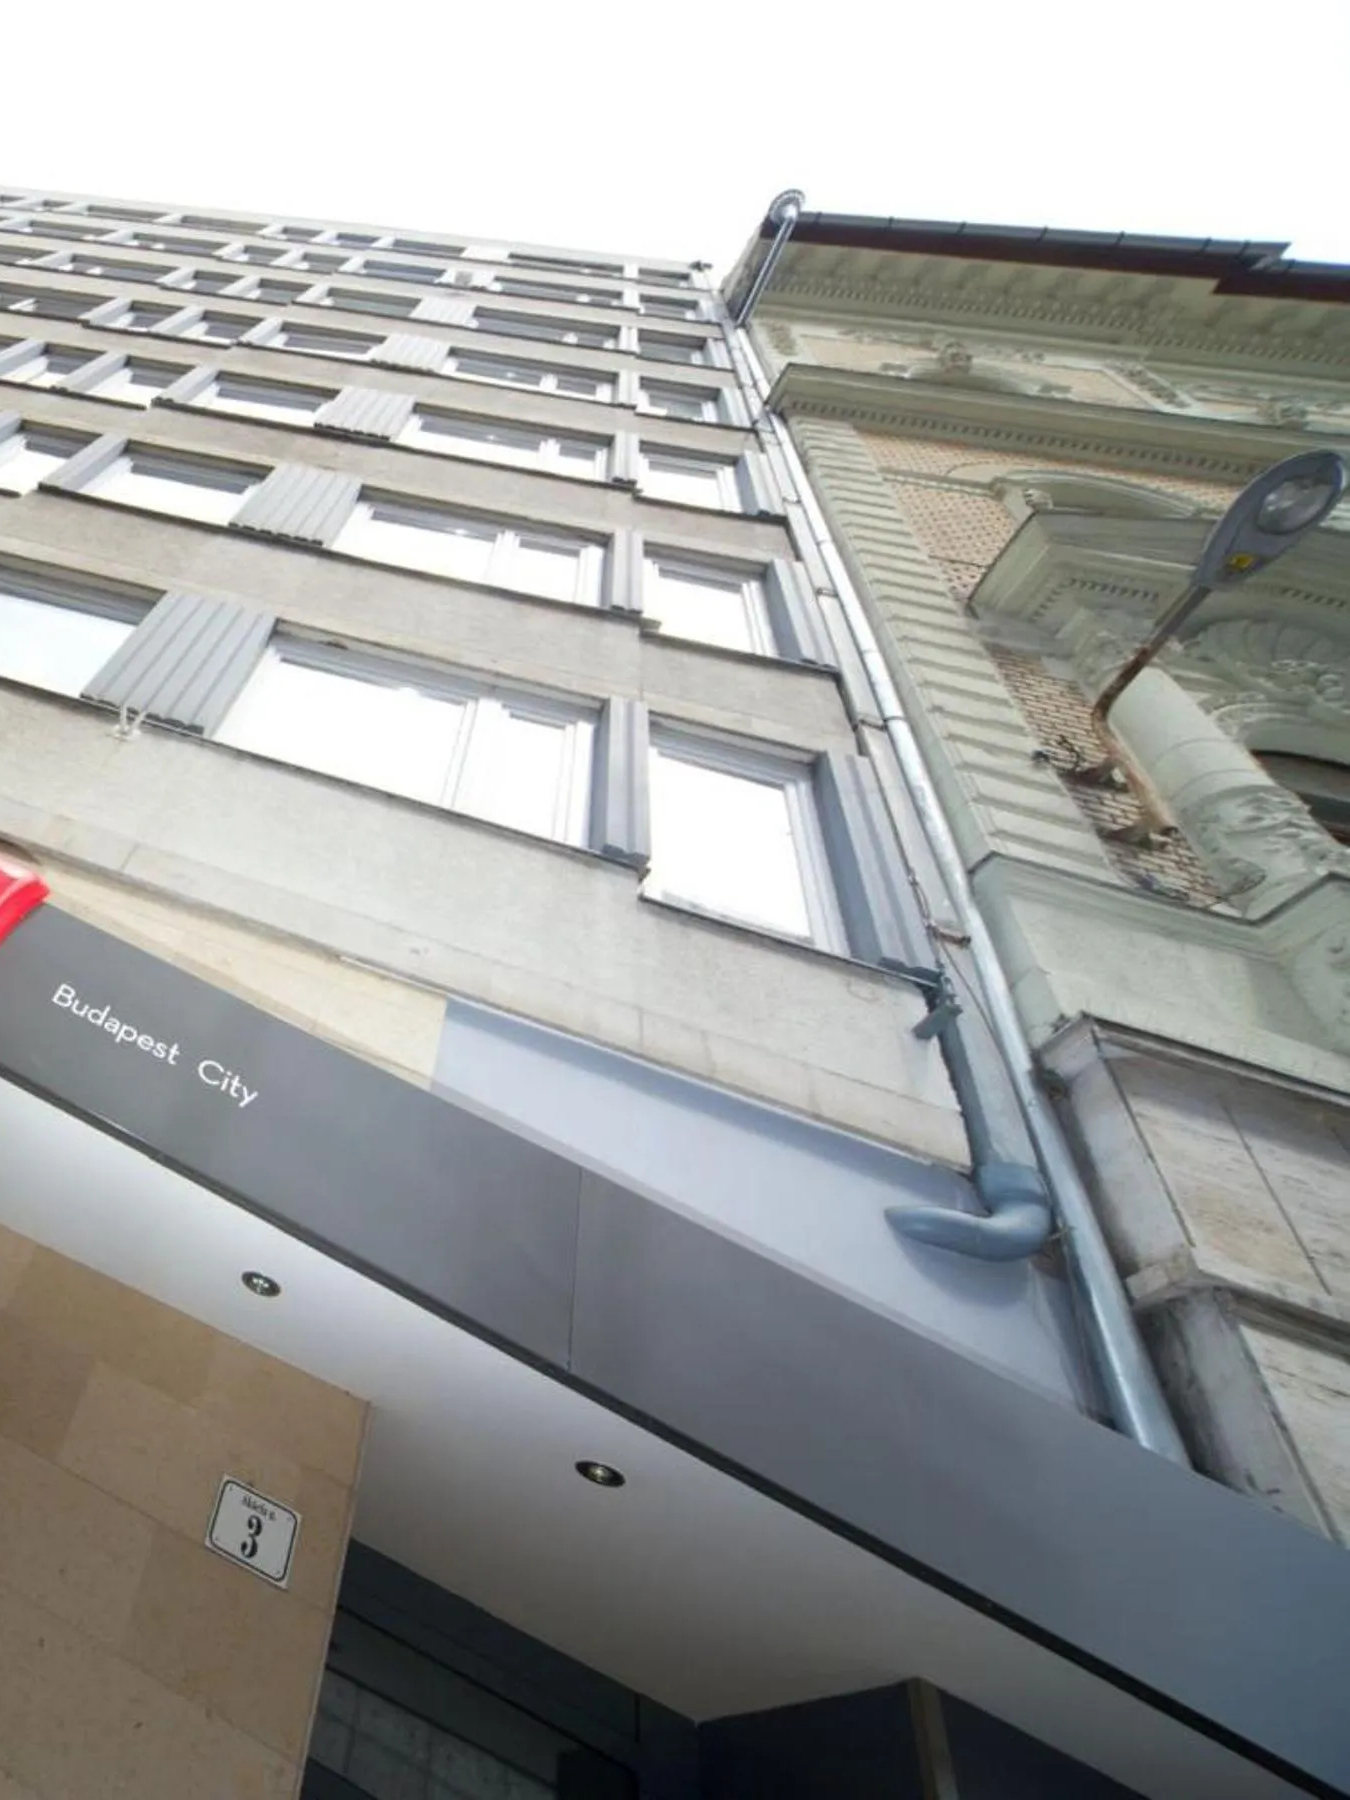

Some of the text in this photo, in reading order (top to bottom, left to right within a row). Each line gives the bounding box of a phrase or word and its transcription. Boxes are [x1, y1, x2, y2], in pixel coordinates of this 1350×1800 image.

[51, 983, 259, 1109] Budapest City
[240, 1514, 263, 1559] 3
